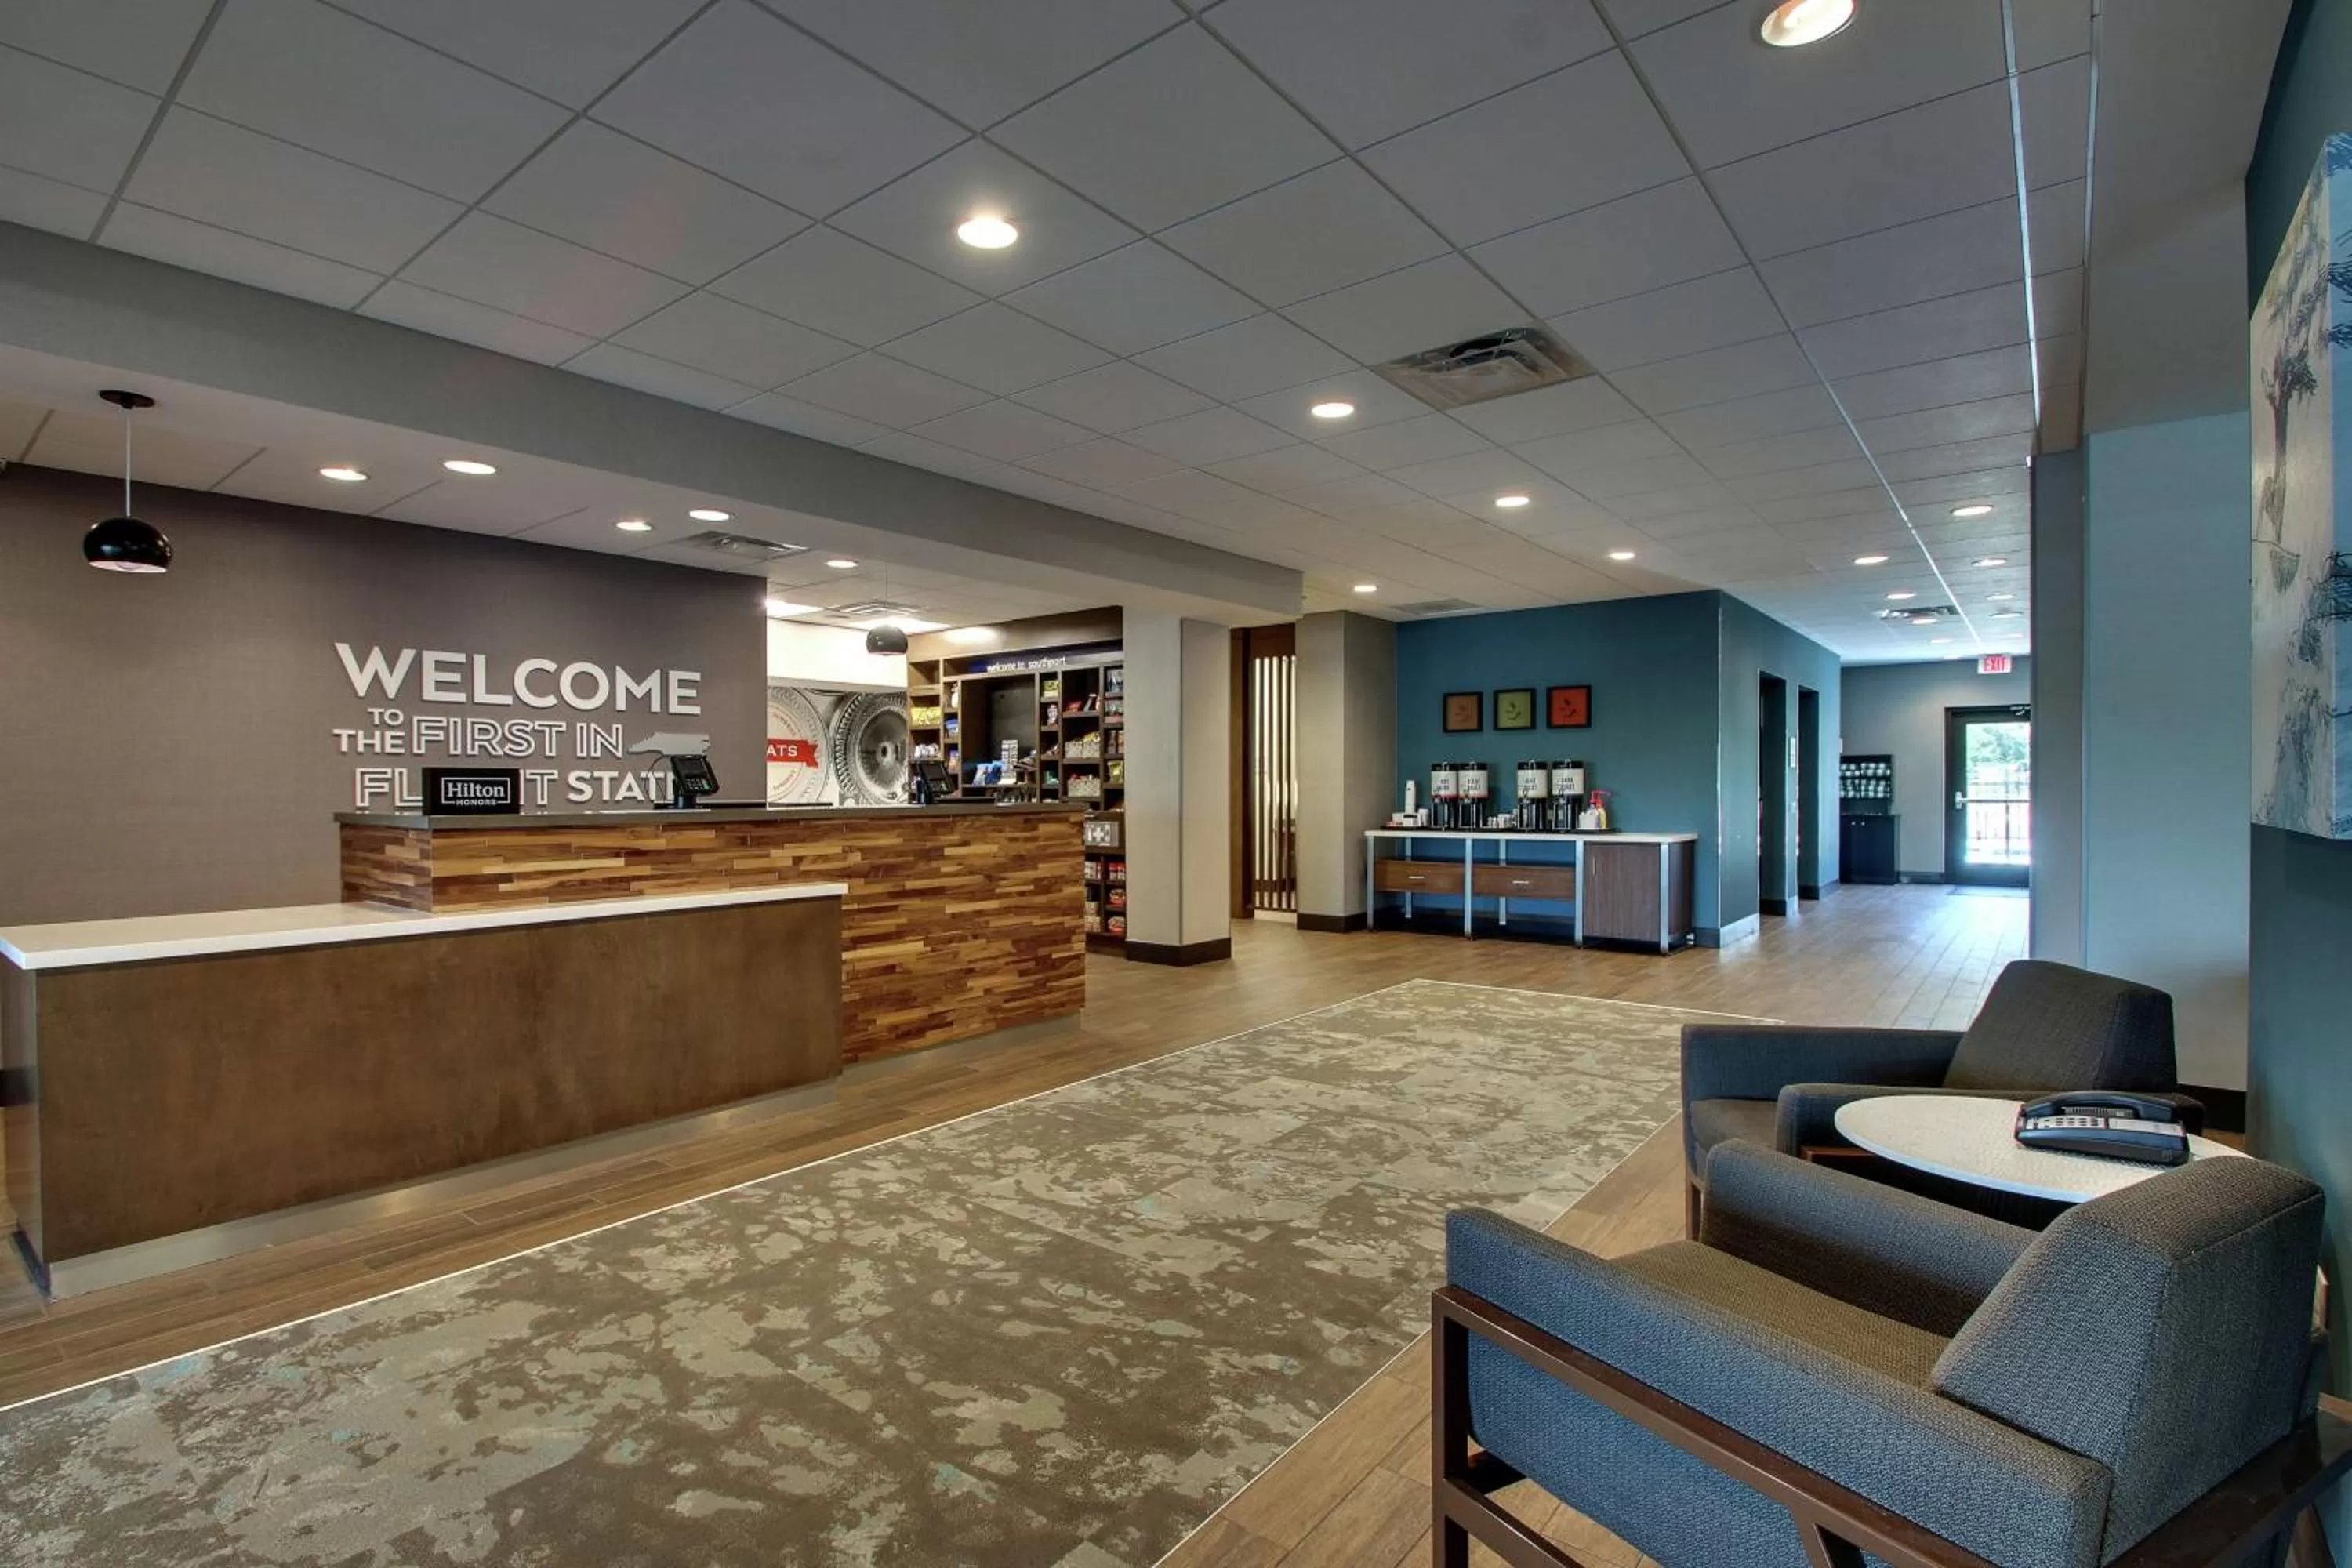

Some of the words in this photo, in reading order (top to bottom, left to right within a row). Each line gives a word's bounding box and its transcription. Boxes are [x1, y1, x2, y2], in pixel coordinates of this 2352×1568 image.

[1984, 656, 2007, 672] EXIT
[335, 642, 702, 715] WELCOME
[368, 708, 405, 726] TO
[332, 728, 405, 754] THE
[412, 715, 567, 757] FIRST
[576, 722, 623, 759] IN
[356, 768, 559, 807] FLT
[447, 782, 506, 798] Hilton
[456, 798, 498, 807] HONORS
